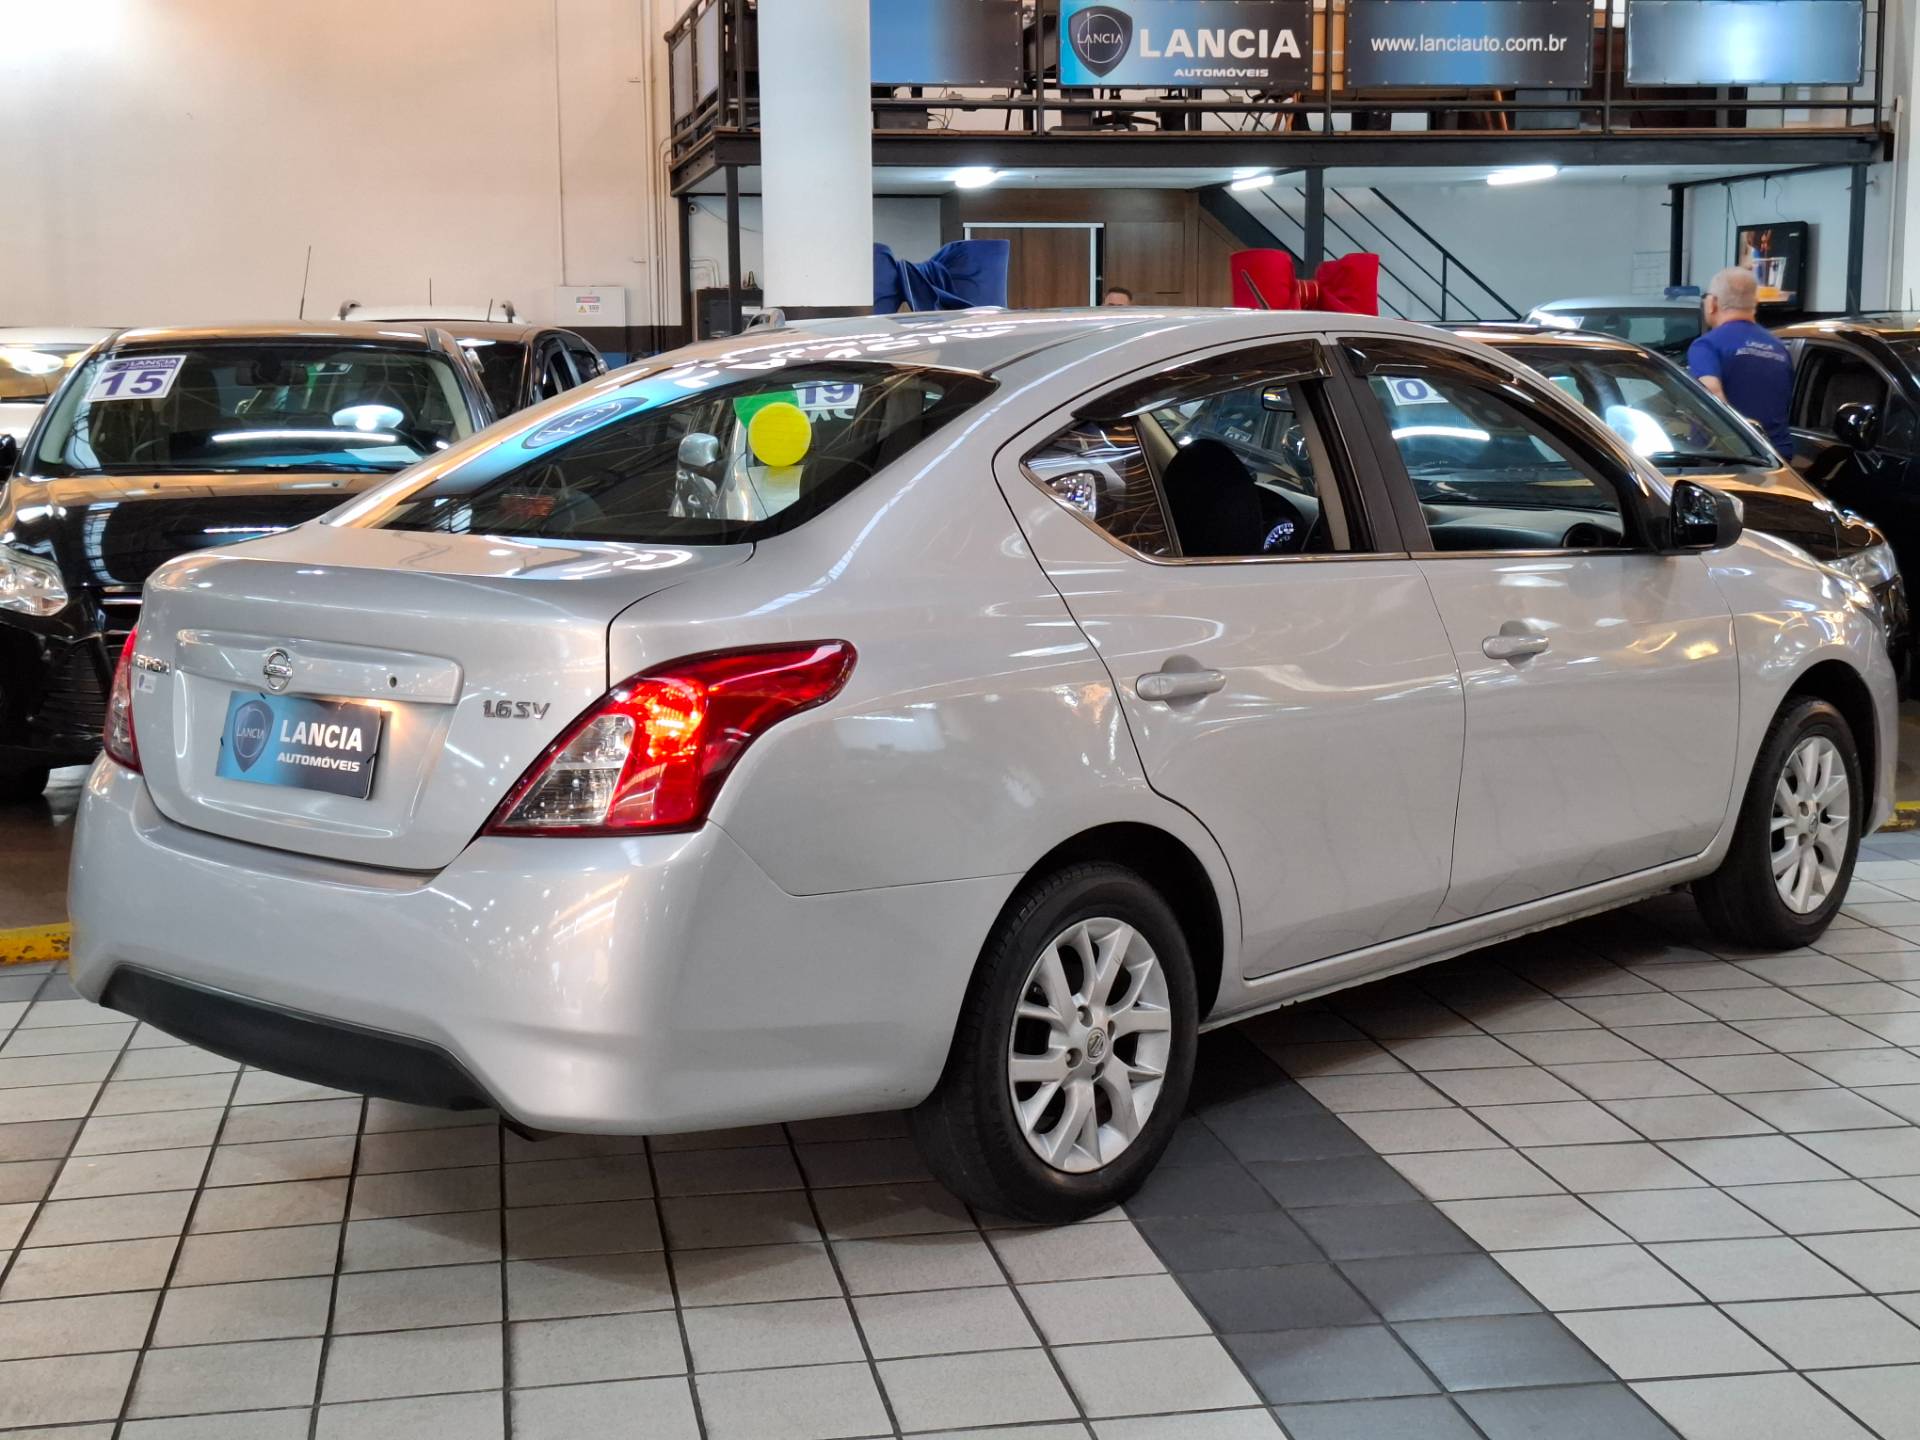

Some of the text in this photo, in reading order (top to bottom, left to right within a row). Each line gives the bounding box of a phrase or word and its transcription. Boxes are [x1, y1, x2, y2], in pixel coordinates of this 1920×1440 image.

[1077, 33, 1124, 45] LANCIA
[1139, 29, 1302, 59] LANCIA
[1371, 34, 1568, 52] www.lanciauto.com.br
[1174, 67, 1269, 78] AUTOMÓVEIS
[101, 370, 168, 396] 15
[236, 725, 265, 739] LANCIA
[279, 720, 363, 752] LANCIA
[277, 752, 361, 772] AUTOMÓVEIS
